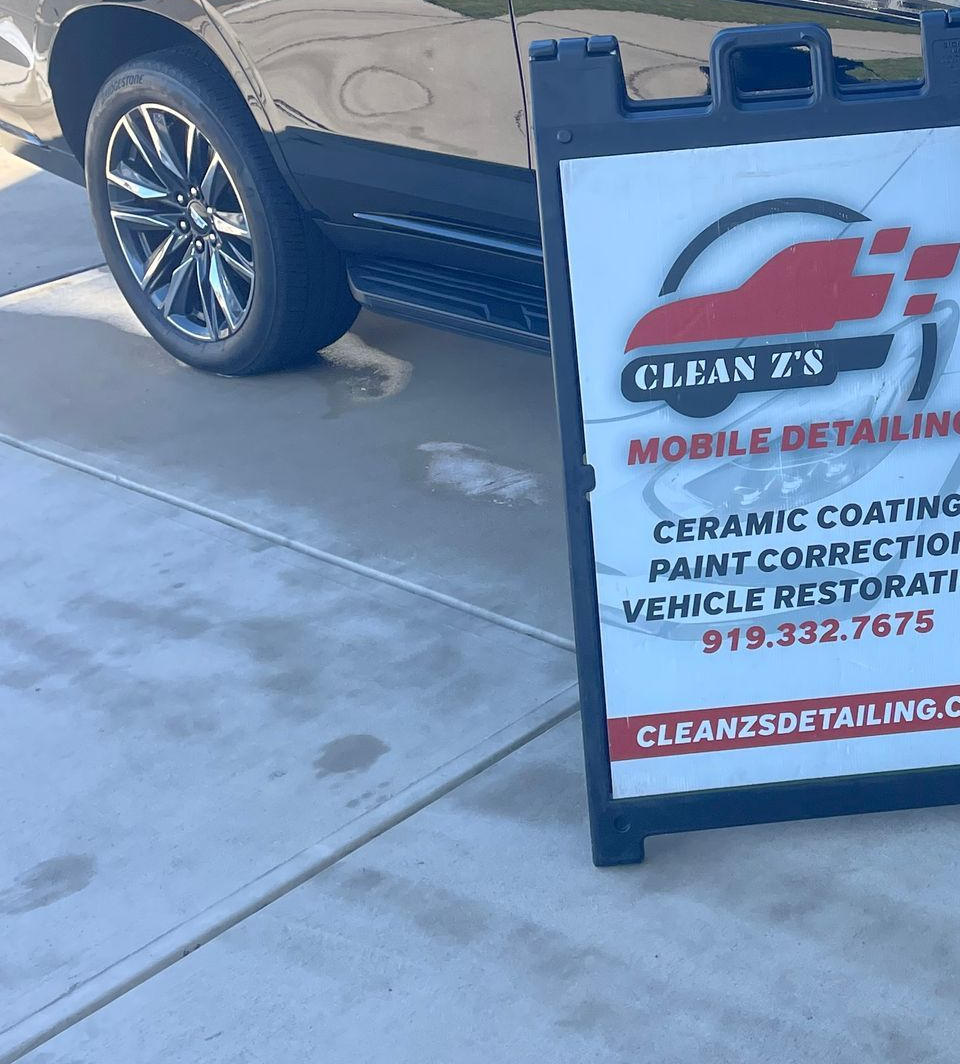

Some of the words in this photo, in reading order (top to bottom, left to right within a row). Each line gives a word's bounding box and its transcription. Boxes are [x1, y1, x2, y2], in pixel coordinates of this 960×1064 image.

[634, 354, 757, 391] CLEAN
[770, 347, 825, 379] Z'S
[627, 427, 772, 466] MOBILE
[653, 507, 808, 544] CERAMIC
[648, 551, 751, 583] PAINT
[622, 587, 766, 624] VEHICLE
[702, 609, 935, 654] 919.332.7675
